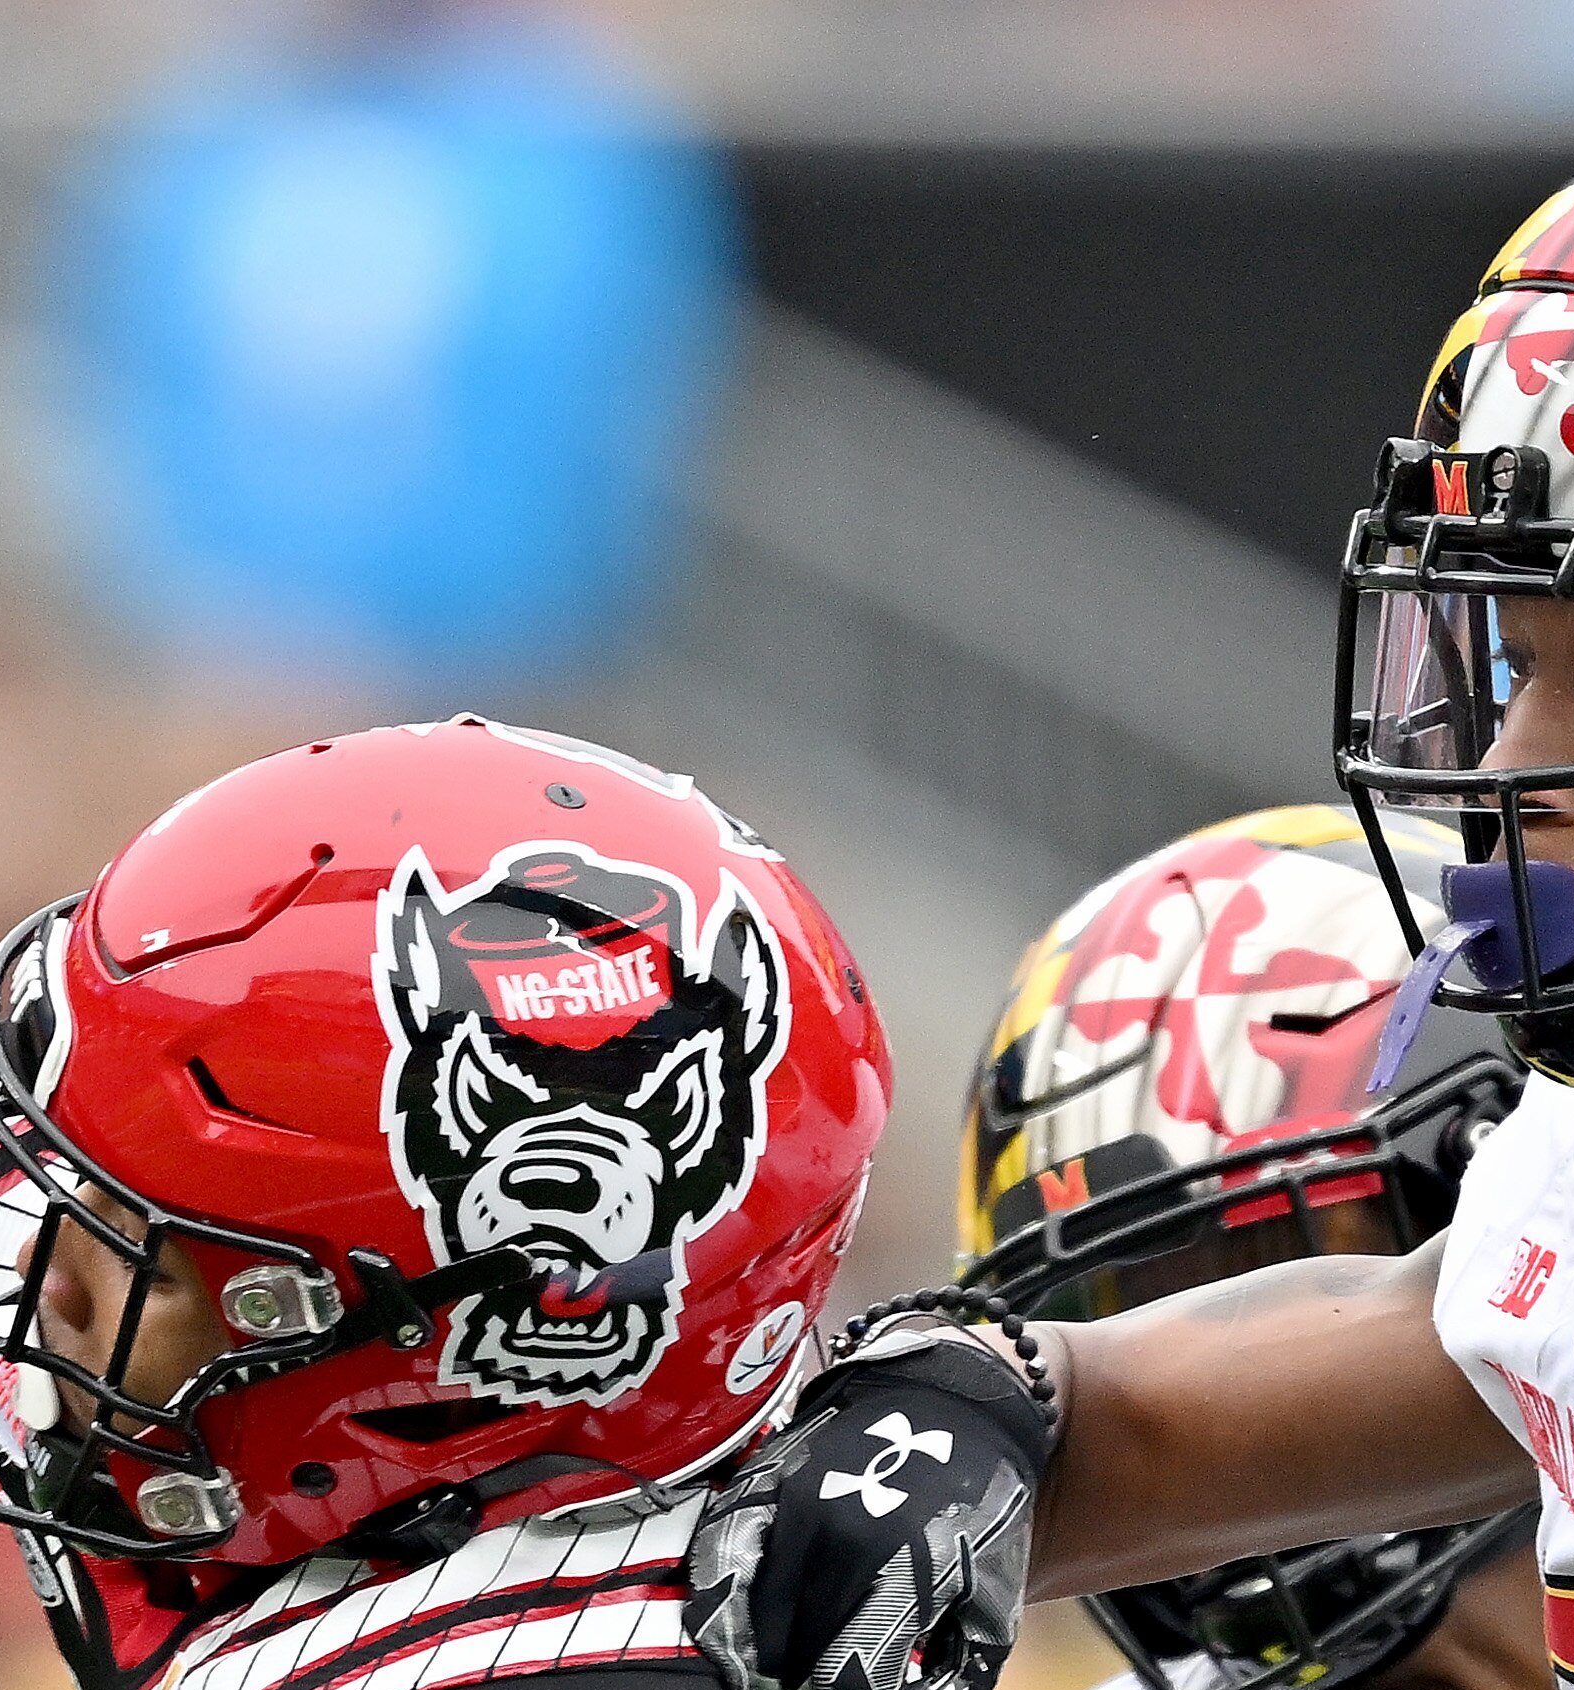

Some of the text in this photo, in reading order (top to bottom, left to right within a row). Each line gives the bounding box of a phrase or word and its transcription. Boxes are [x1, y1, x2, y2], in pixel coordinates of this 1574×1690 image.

[1432, 458, 1472, 516] M
[496, 944, 662, 1022] NC STATE
